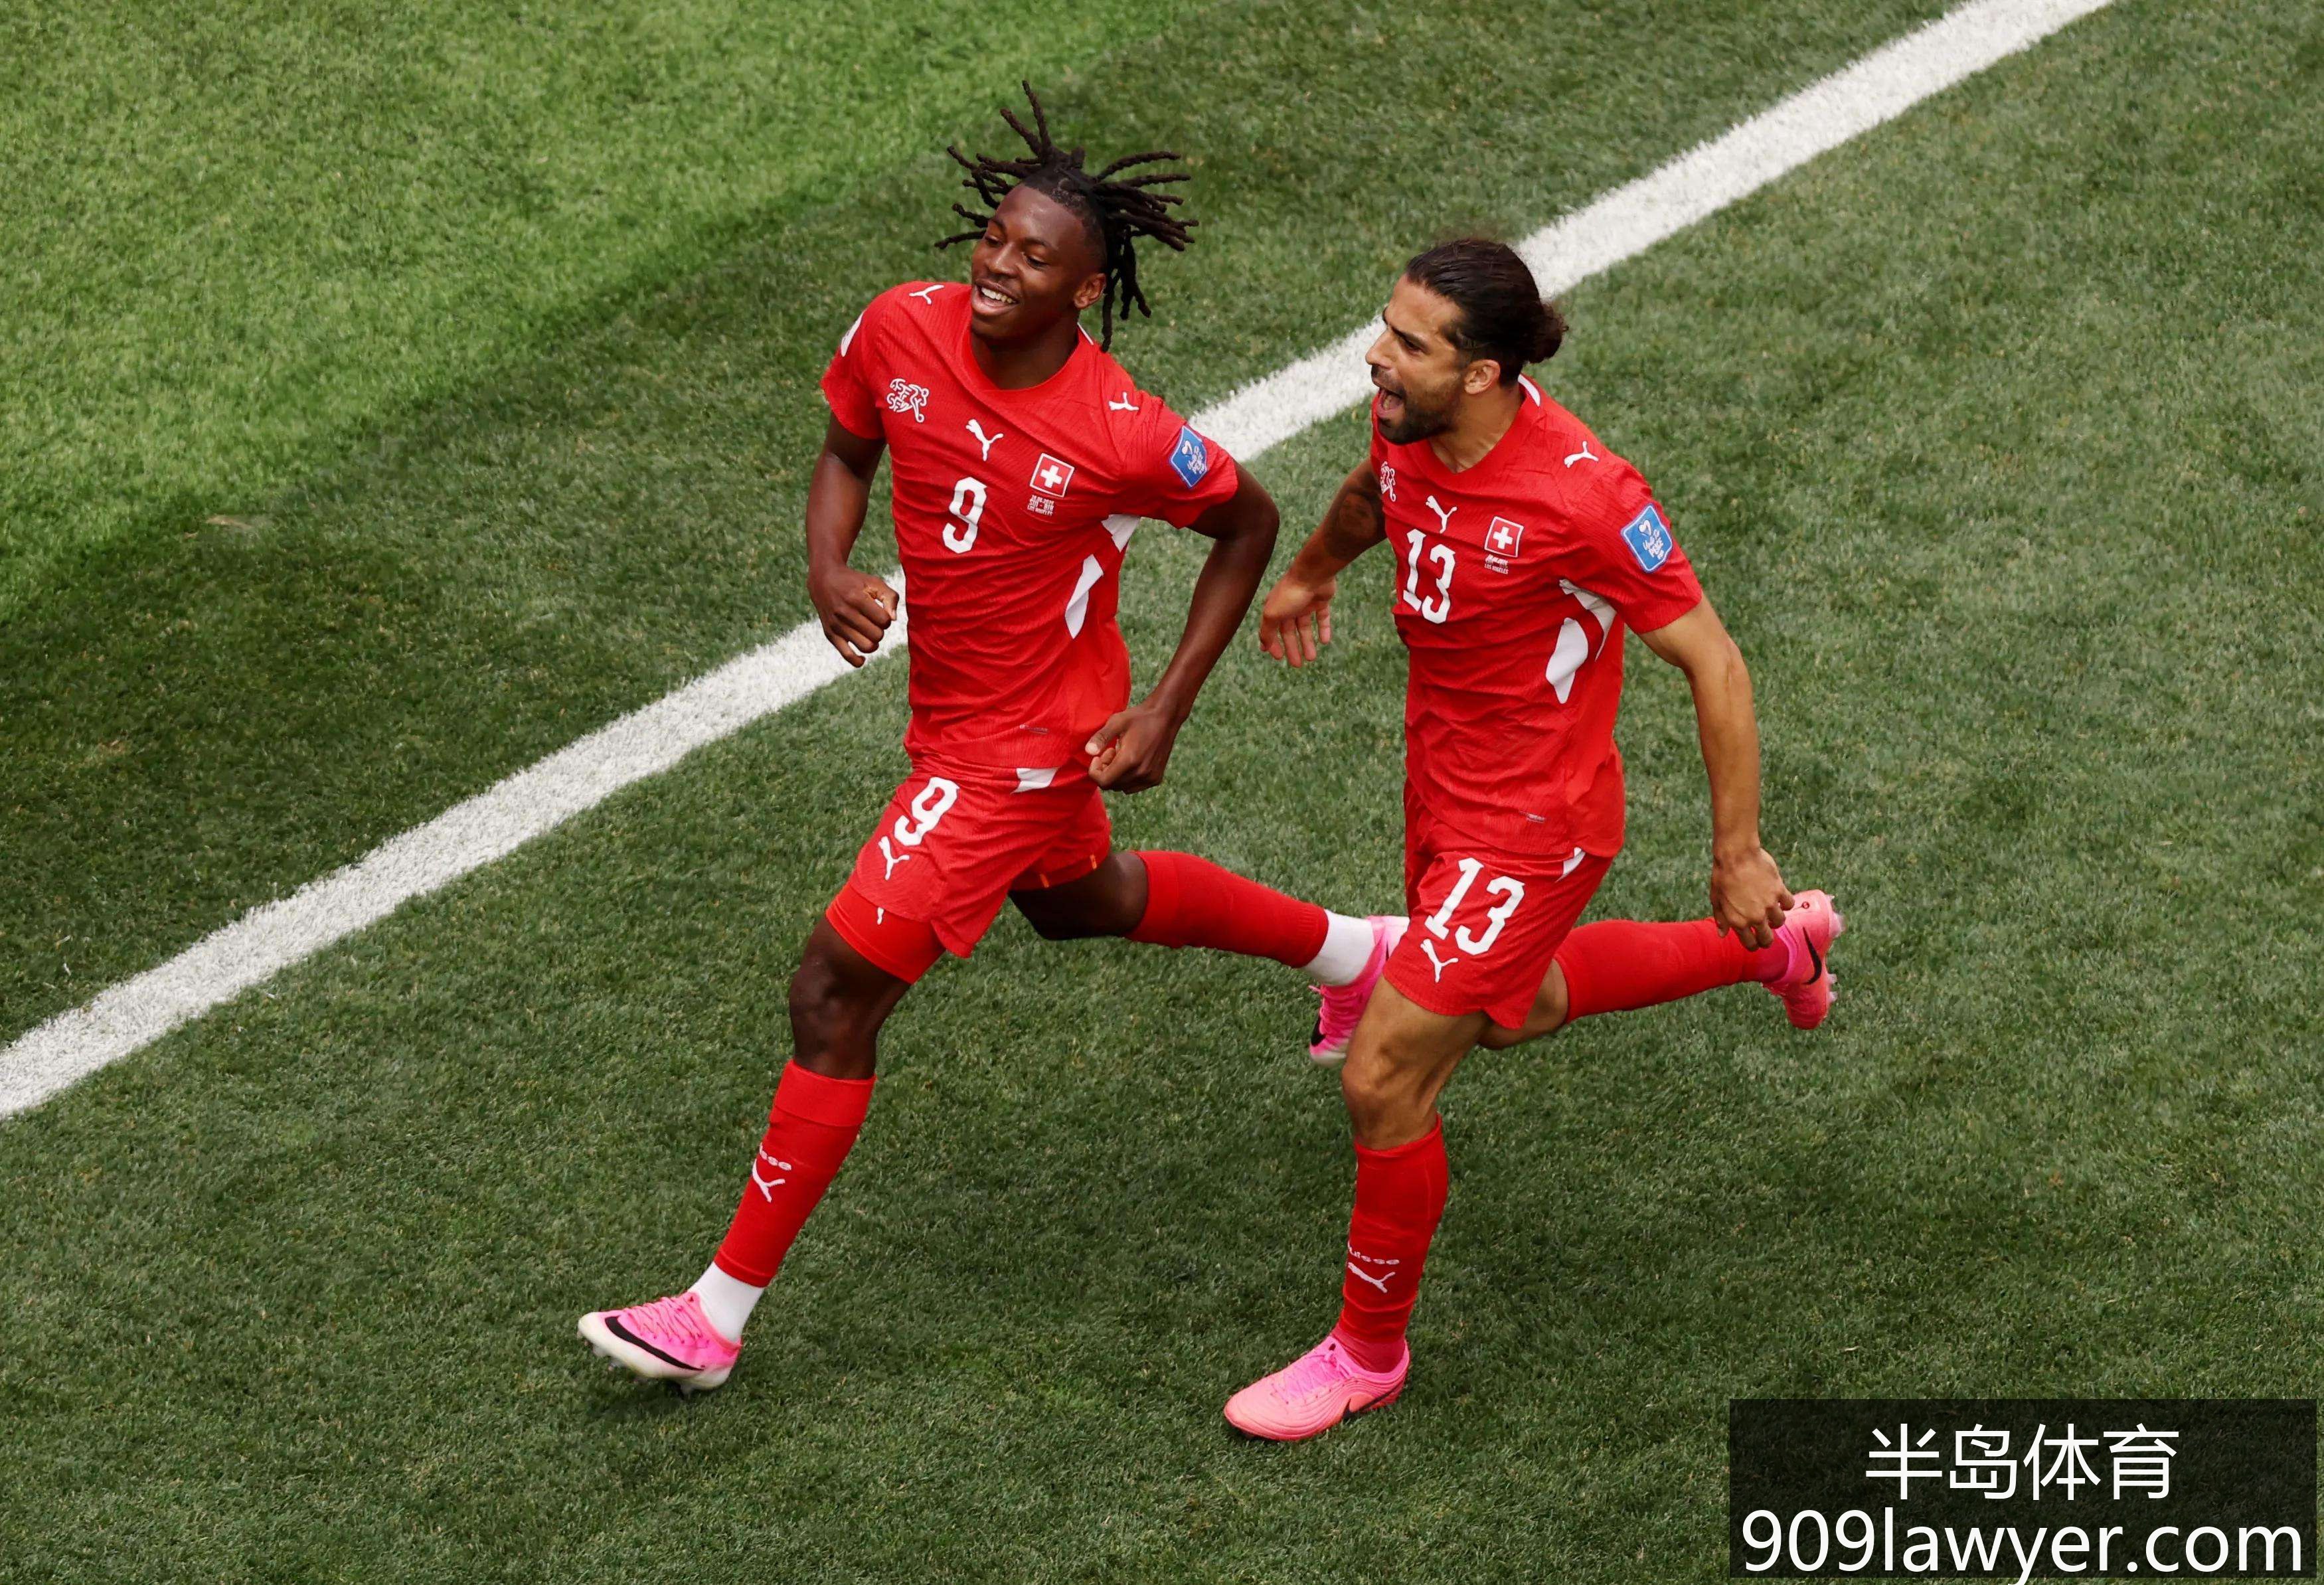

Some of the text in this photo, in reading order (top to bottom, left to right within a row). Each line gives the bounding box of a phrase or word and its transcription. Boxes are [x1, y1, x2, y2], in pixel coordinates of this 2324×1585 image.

[942, 476, 987, 554] 9
[1403, 529, 1456, 624] 13
[894, 776, 960, 847] 9
[1424, 857, 1525, 956] 13
